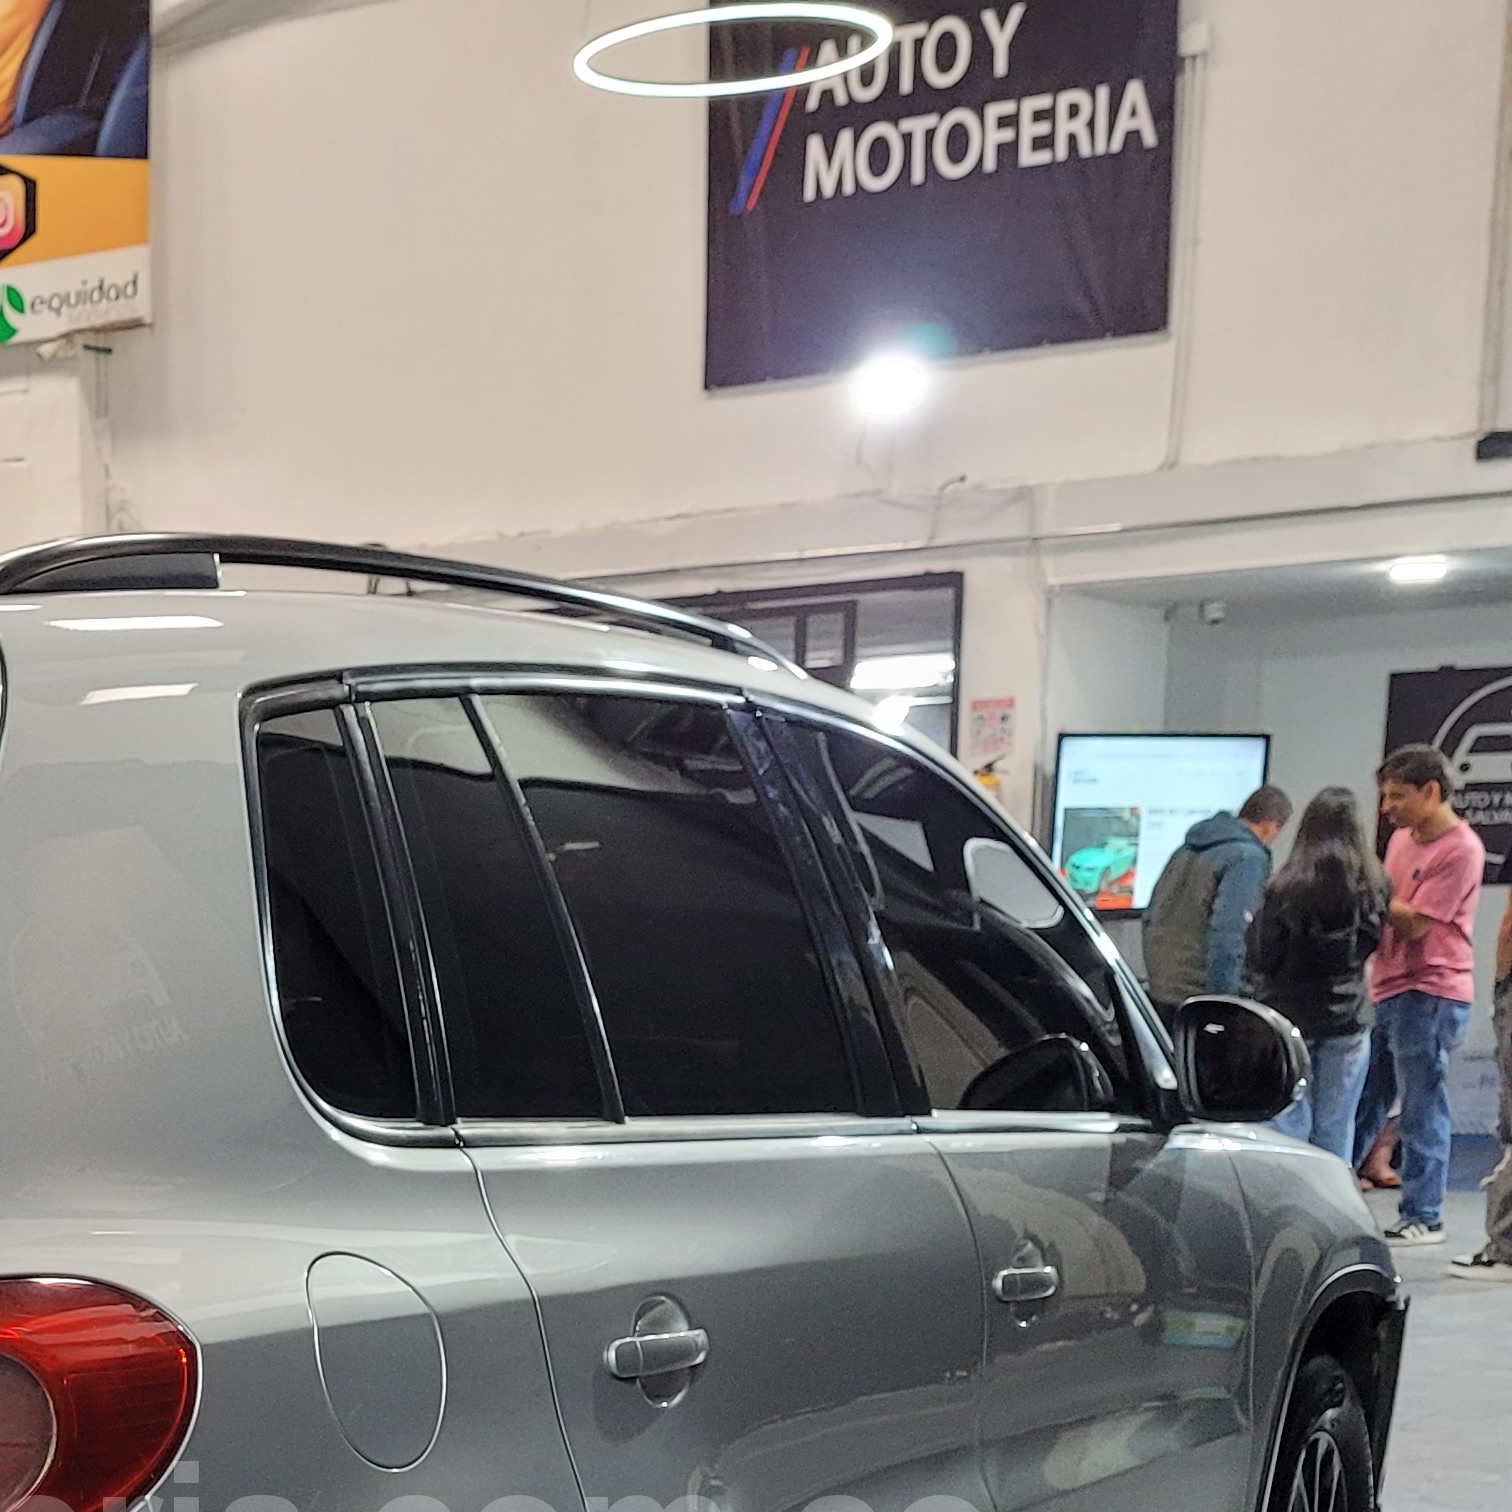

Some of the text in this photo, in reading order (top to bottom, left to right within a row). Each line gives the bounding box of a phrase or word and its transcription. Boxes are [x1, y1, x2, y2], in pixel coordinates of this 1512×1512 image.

[805, 2, 1027, 113] AUTO Y
[802, 78, 1159, 203] MOTOFERIA
[29, 270, 139, 318] equidad
